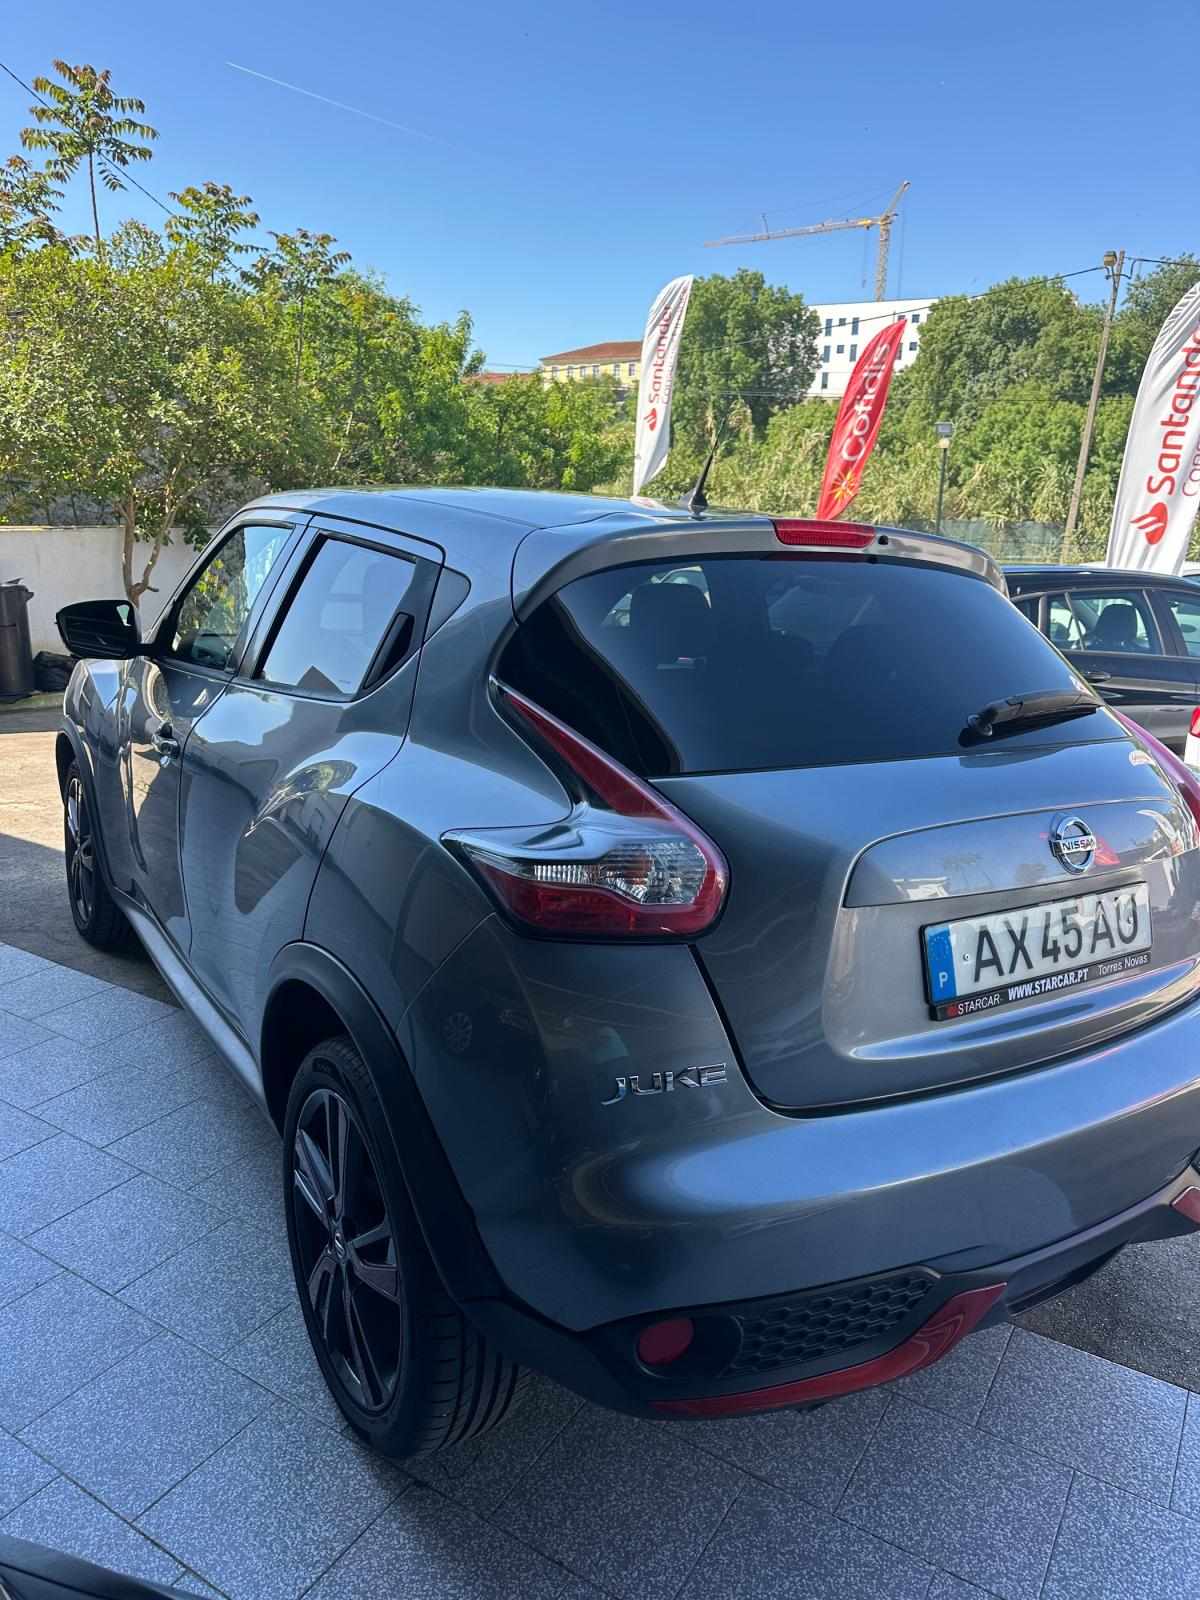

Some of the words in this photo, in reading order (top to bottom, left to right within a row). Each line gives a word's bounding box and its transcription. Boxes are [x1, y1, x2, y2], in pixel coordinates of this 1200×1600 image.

[841, 343, 890, 461] Cofidis
[974, 916, 1033, 983] AX
[1041, 906, 1083, 963] 45
[938, 971, 948, 988] P
[957, 993, 1000, 1015] STARCAR
[1008, 968, 1089, 1001] WWW.STARCAR.PT
[1098, 961, 1123, 976] Torres
[1124, 953, 1149, 969] Novas
[600, 1062, 728, 1106] JUKE
